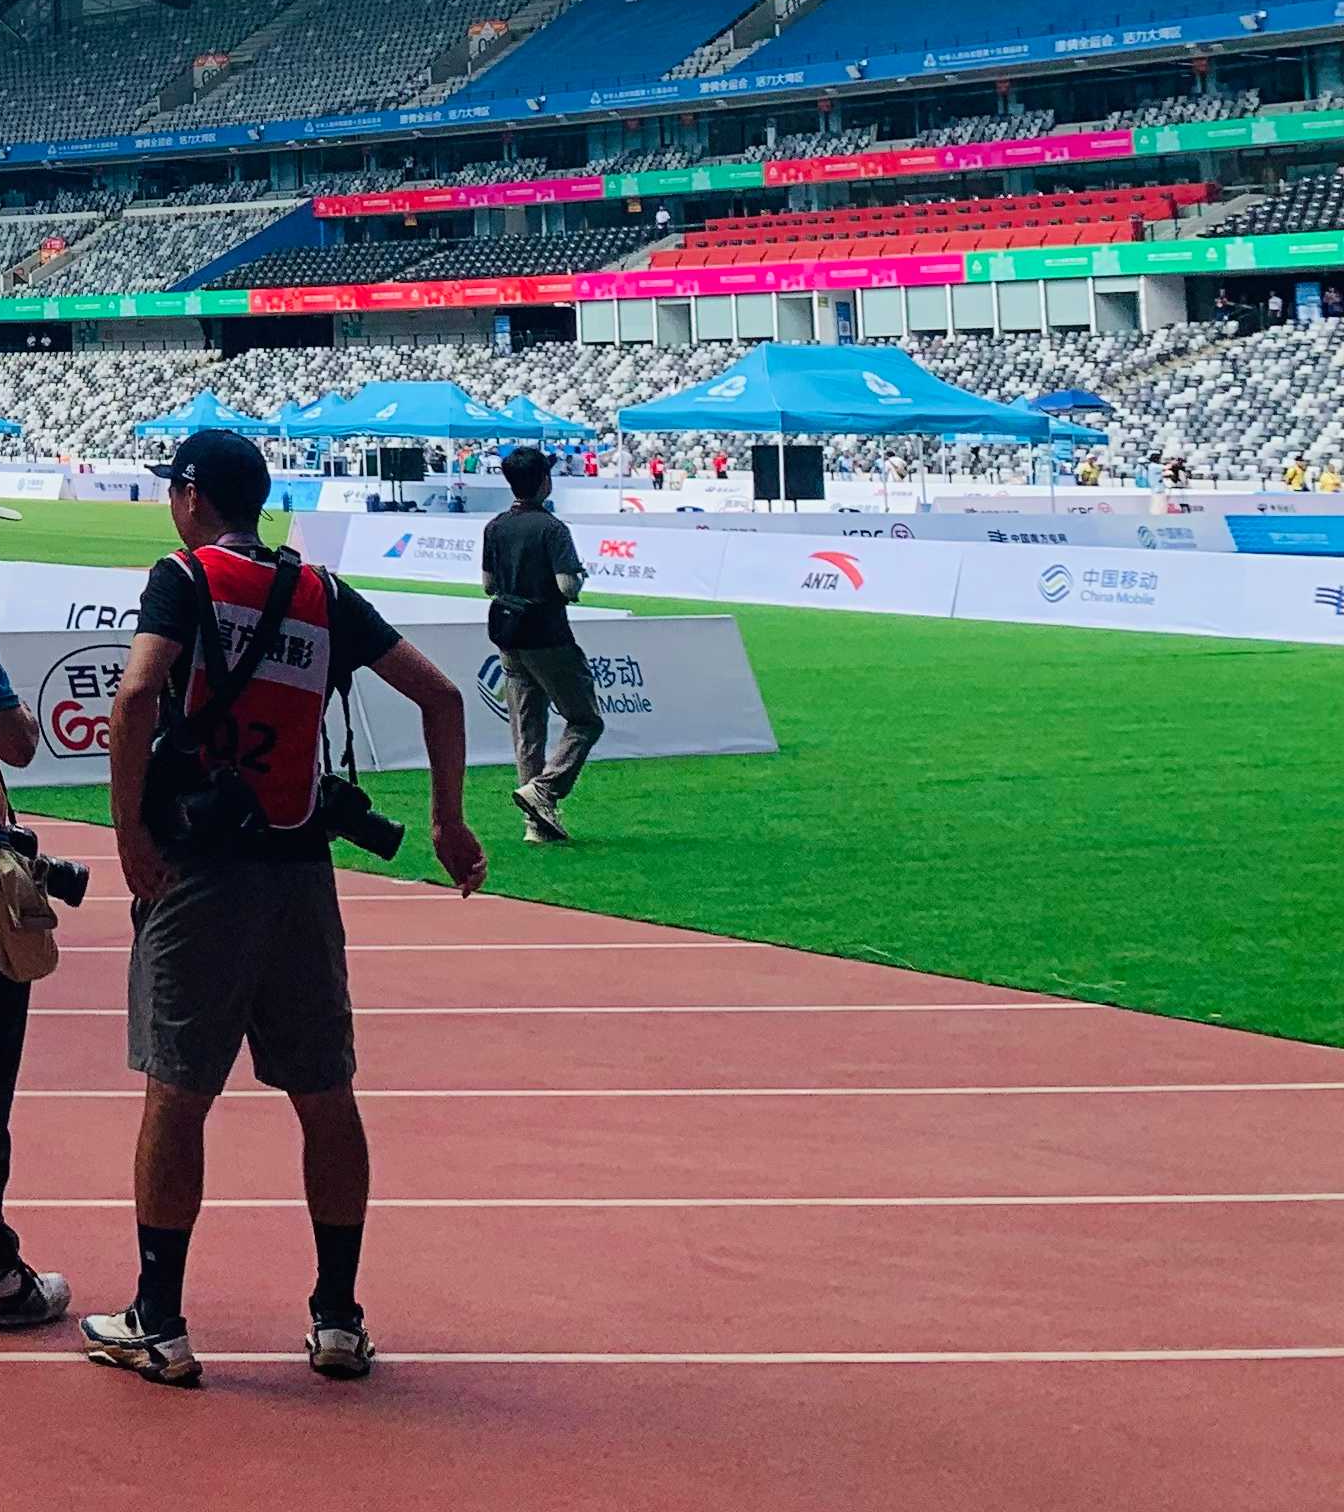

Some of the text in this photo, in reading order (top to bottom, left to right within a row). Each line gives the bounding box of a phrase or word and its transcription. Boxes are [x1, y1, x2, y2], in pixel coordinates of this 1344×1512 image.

[599, 539, 638, 559] PICC
[800, 572, 840, 591] ANTA
[1082, 568, 1159, 590] 中国移动
[1079, 589, 1155, 606] China Mobile
[598, 693, 653, 715] Mobile
